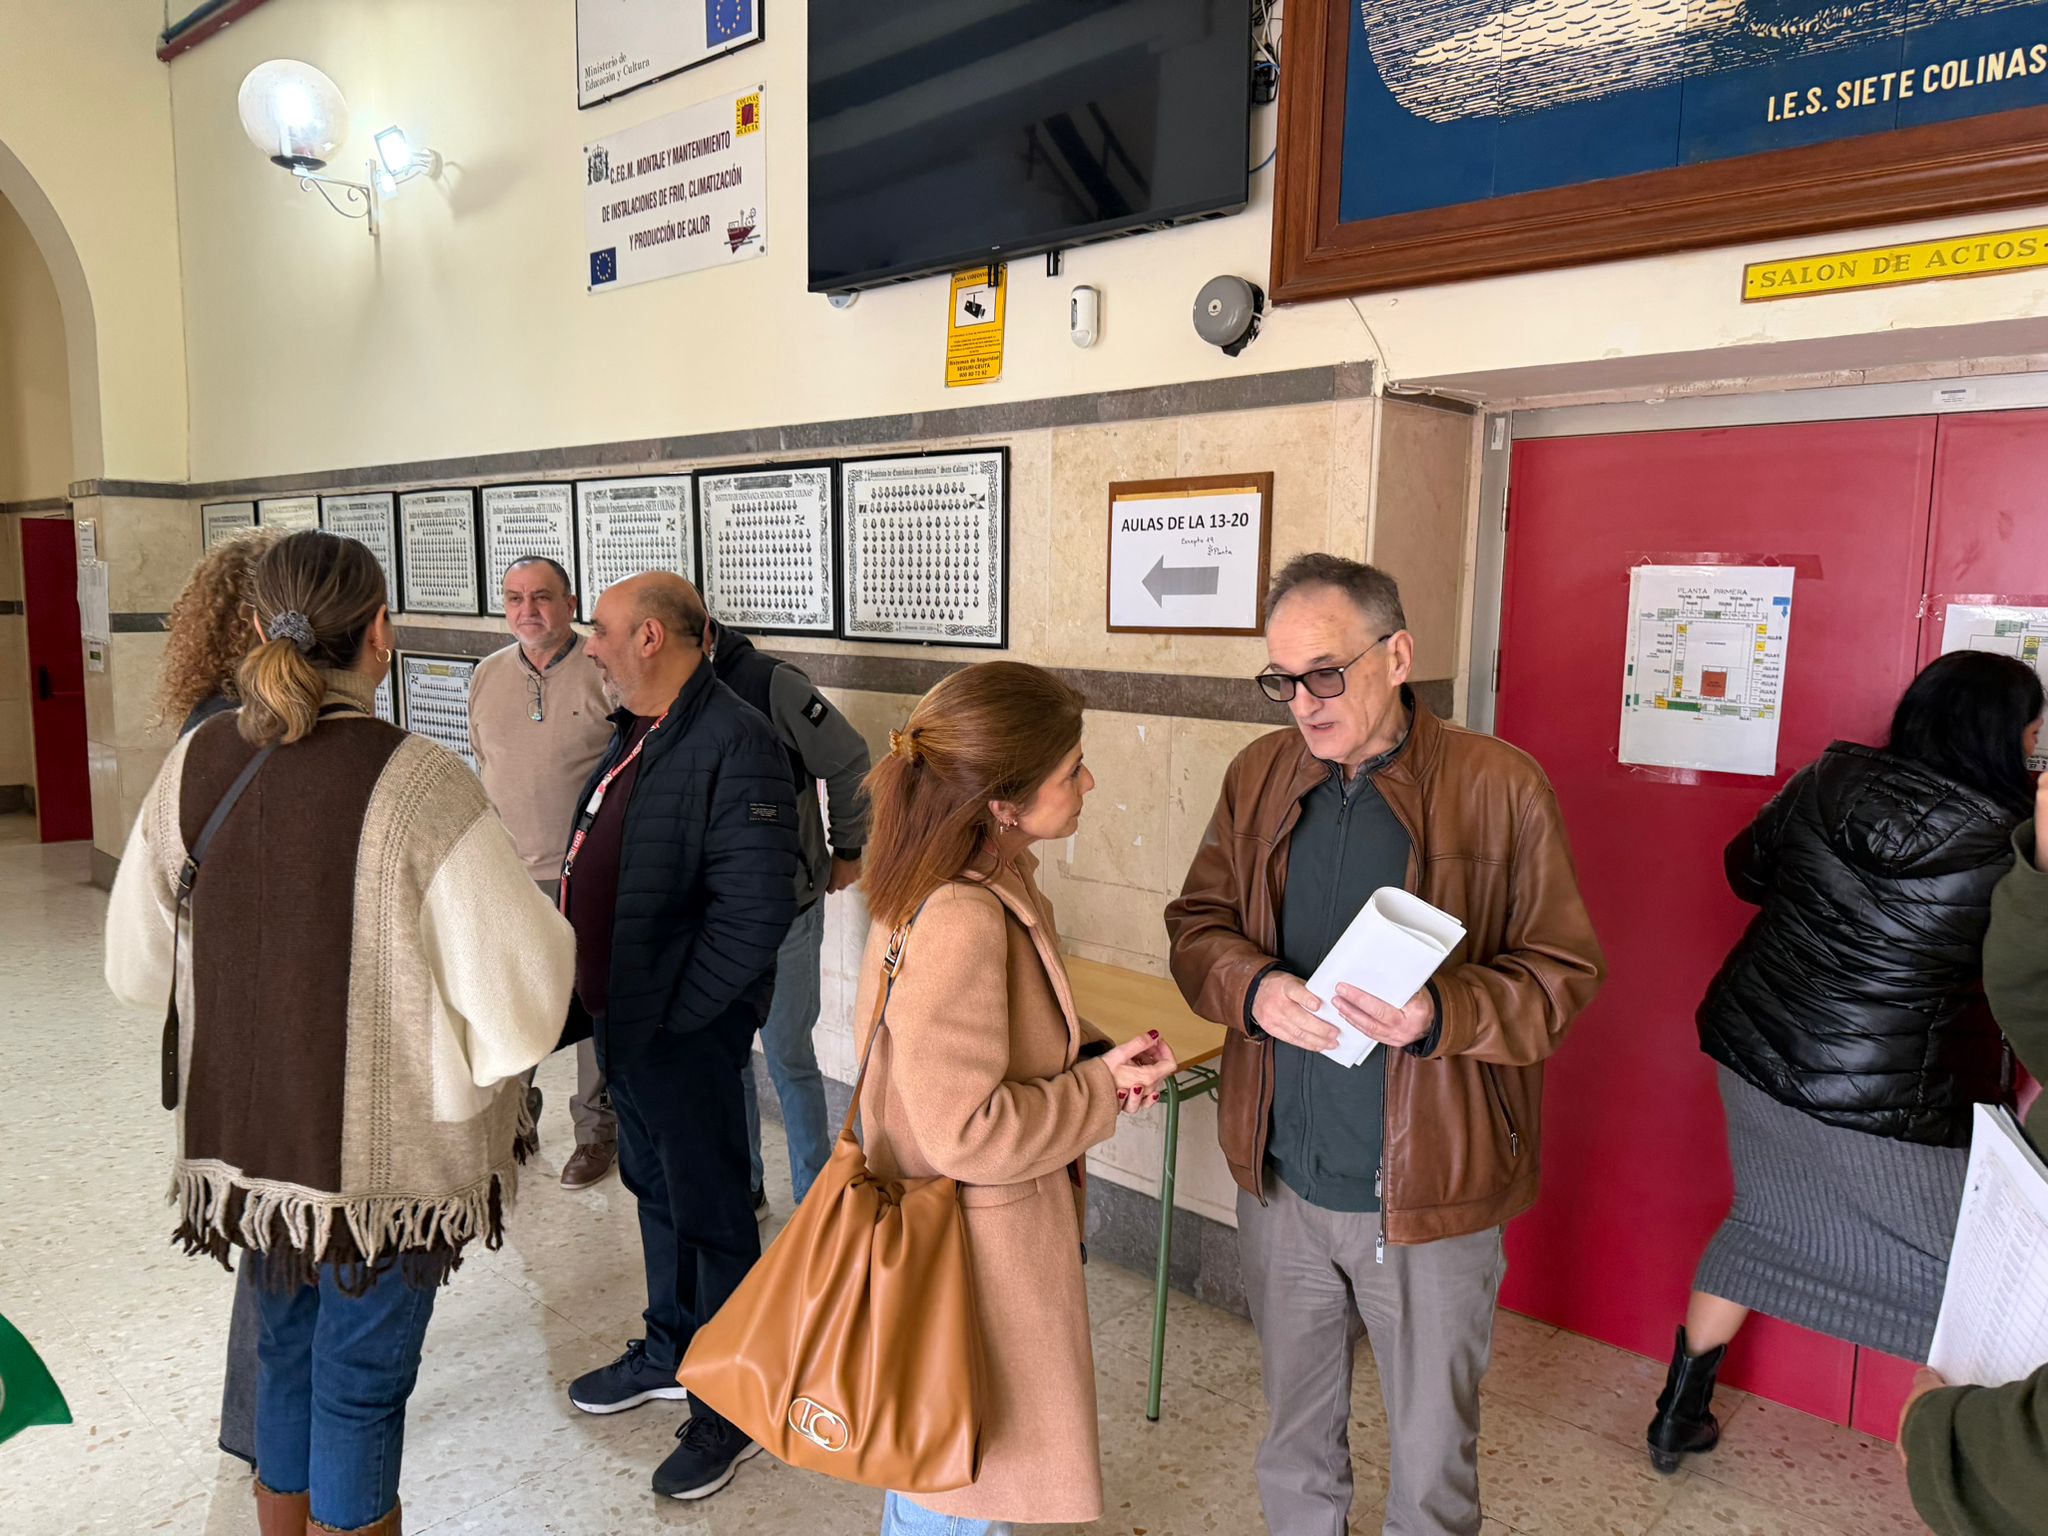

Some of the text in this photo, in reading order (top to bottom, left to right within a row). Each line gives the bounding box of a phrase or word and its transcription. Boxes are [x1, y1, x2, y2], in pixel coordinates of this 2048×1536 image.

[584, 52, 627, 78] Ministerio de
[585, 59, 650, 92] Educación y Cultura
[1767, 43, 2048, 122] I.E.S. SIETE COLINAS
[637, 151, 666, 176] MONTAJE
[667, 149, 673, 167] Y
[672, 130, 731, 163] MANTENIMIENTO
[602, 163, 742, 223] DE INSTALACIONES DE FRIO, CLIMATIZACIÓN
[629, 215, 711, 251] Y PRODUCCIÓN DE CALOR
[1759, 237, 2038, 289] SALON DE ACTOS
[1121, 512, 1249, 532] AULAS DE LA 13-20
[1714, 588, 1748, 596] PRIMERA
